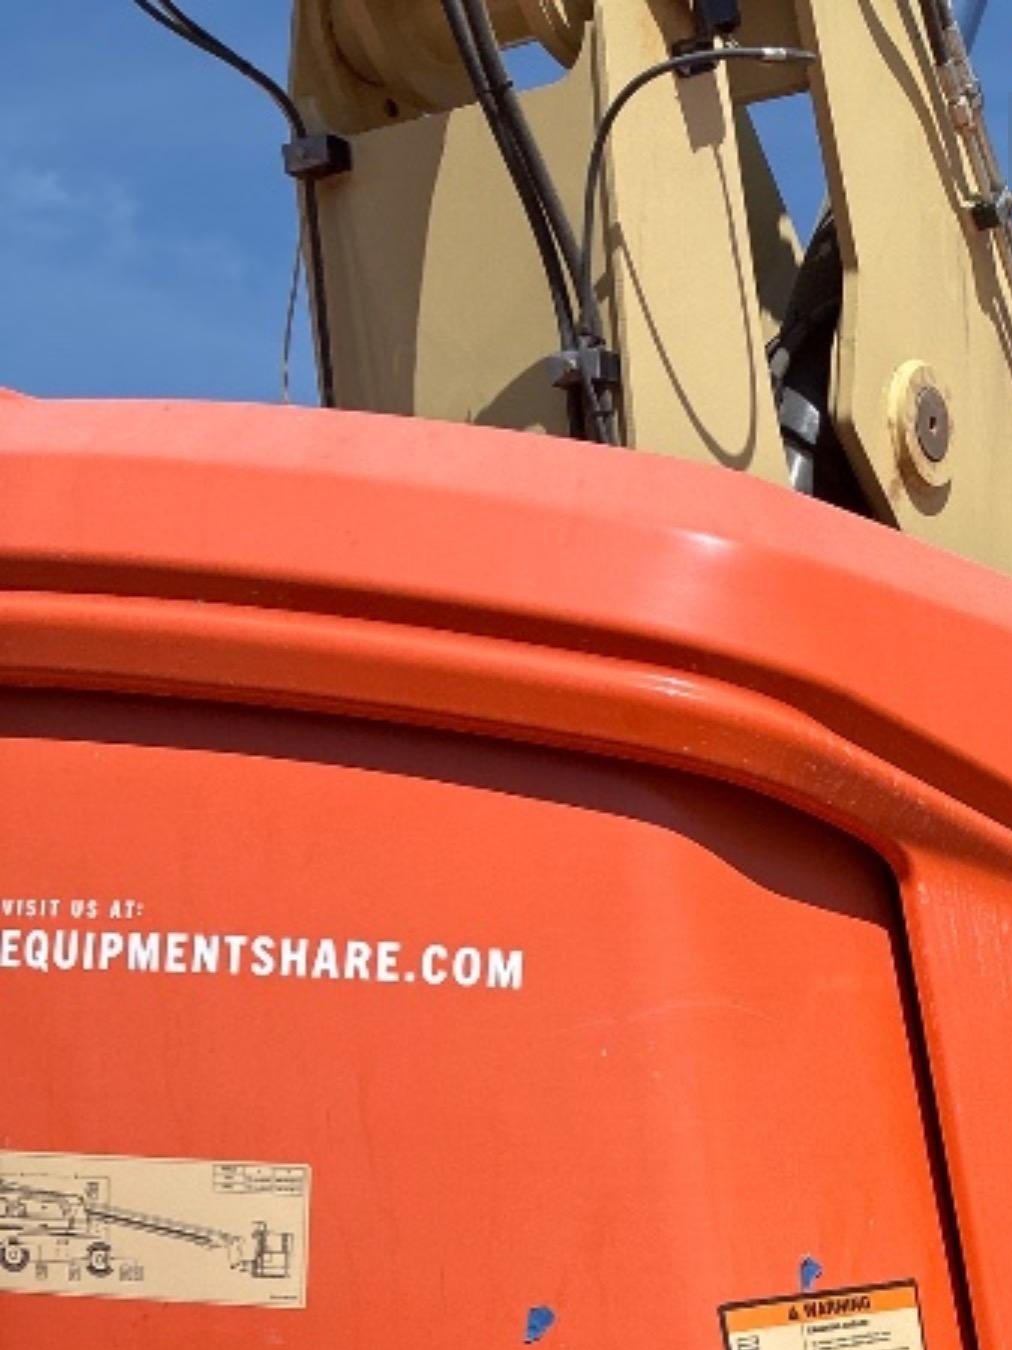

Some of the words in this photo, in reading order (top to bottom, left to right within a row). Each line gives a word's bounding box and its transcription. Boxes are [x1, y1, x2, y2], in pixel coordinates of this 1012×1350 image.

[1, 898, 61, 917] VISIT
[70, 900, 98, 919] US
[109, 901, 144, 919] AT:
[0, 928, 525, 990] EQUIPMENTSHARE.COM
[803, 1295, 871, 1319] WARNING
